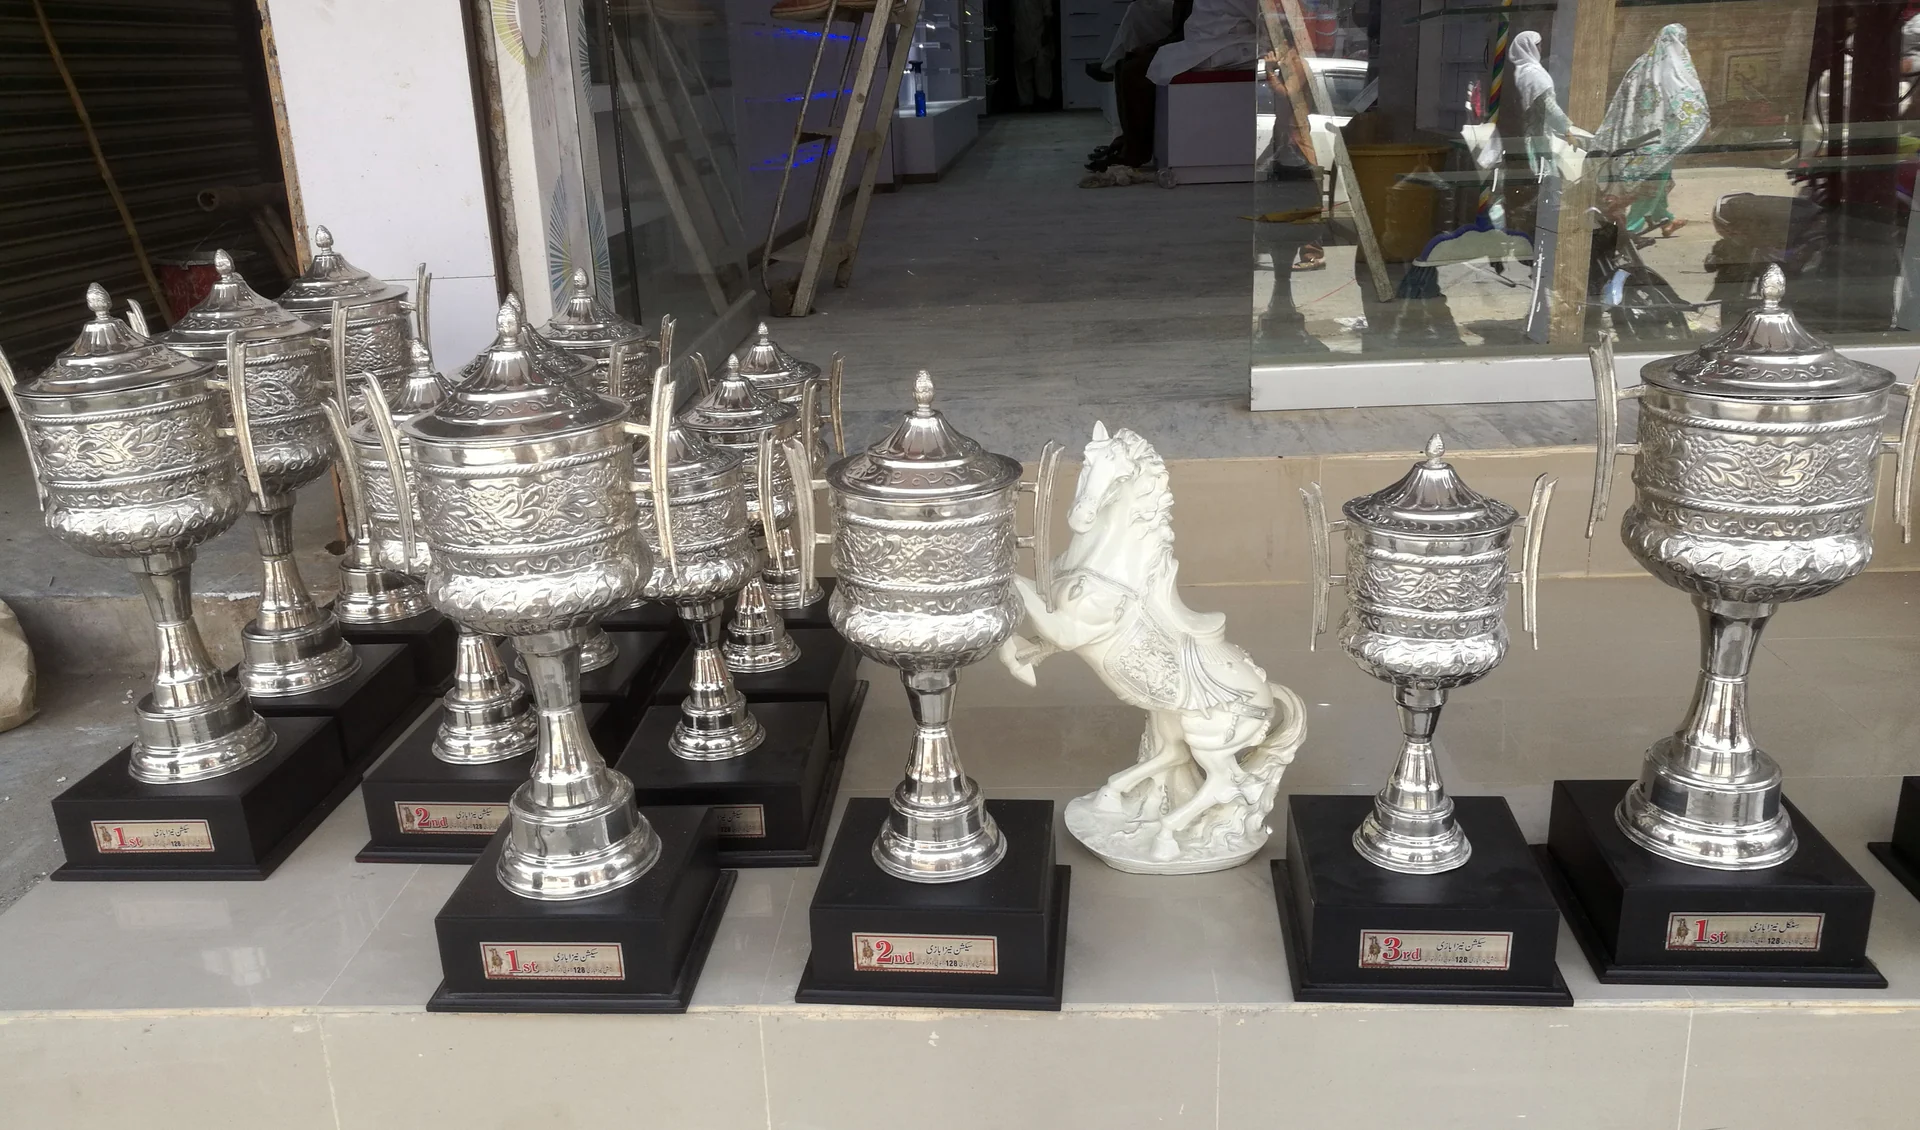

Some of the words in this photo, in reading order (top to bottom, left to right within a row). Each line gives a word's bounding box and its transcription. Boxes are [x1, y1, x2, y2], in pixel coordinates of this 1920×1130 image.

[415, 807, 448, 829] 2nd
[113, 827, 143, 847] 1st
[1694, 919, 1727, 944] 1st
[1767, 937, 1781, 945] 128
[875, 940, 915, 965] 2nd
[1382, 936, 1422, 961] 3rd
[505, 949, 539, 973] 1st
[573, 966, 586, 974] 128
[946, 959, 958, 967] 128
